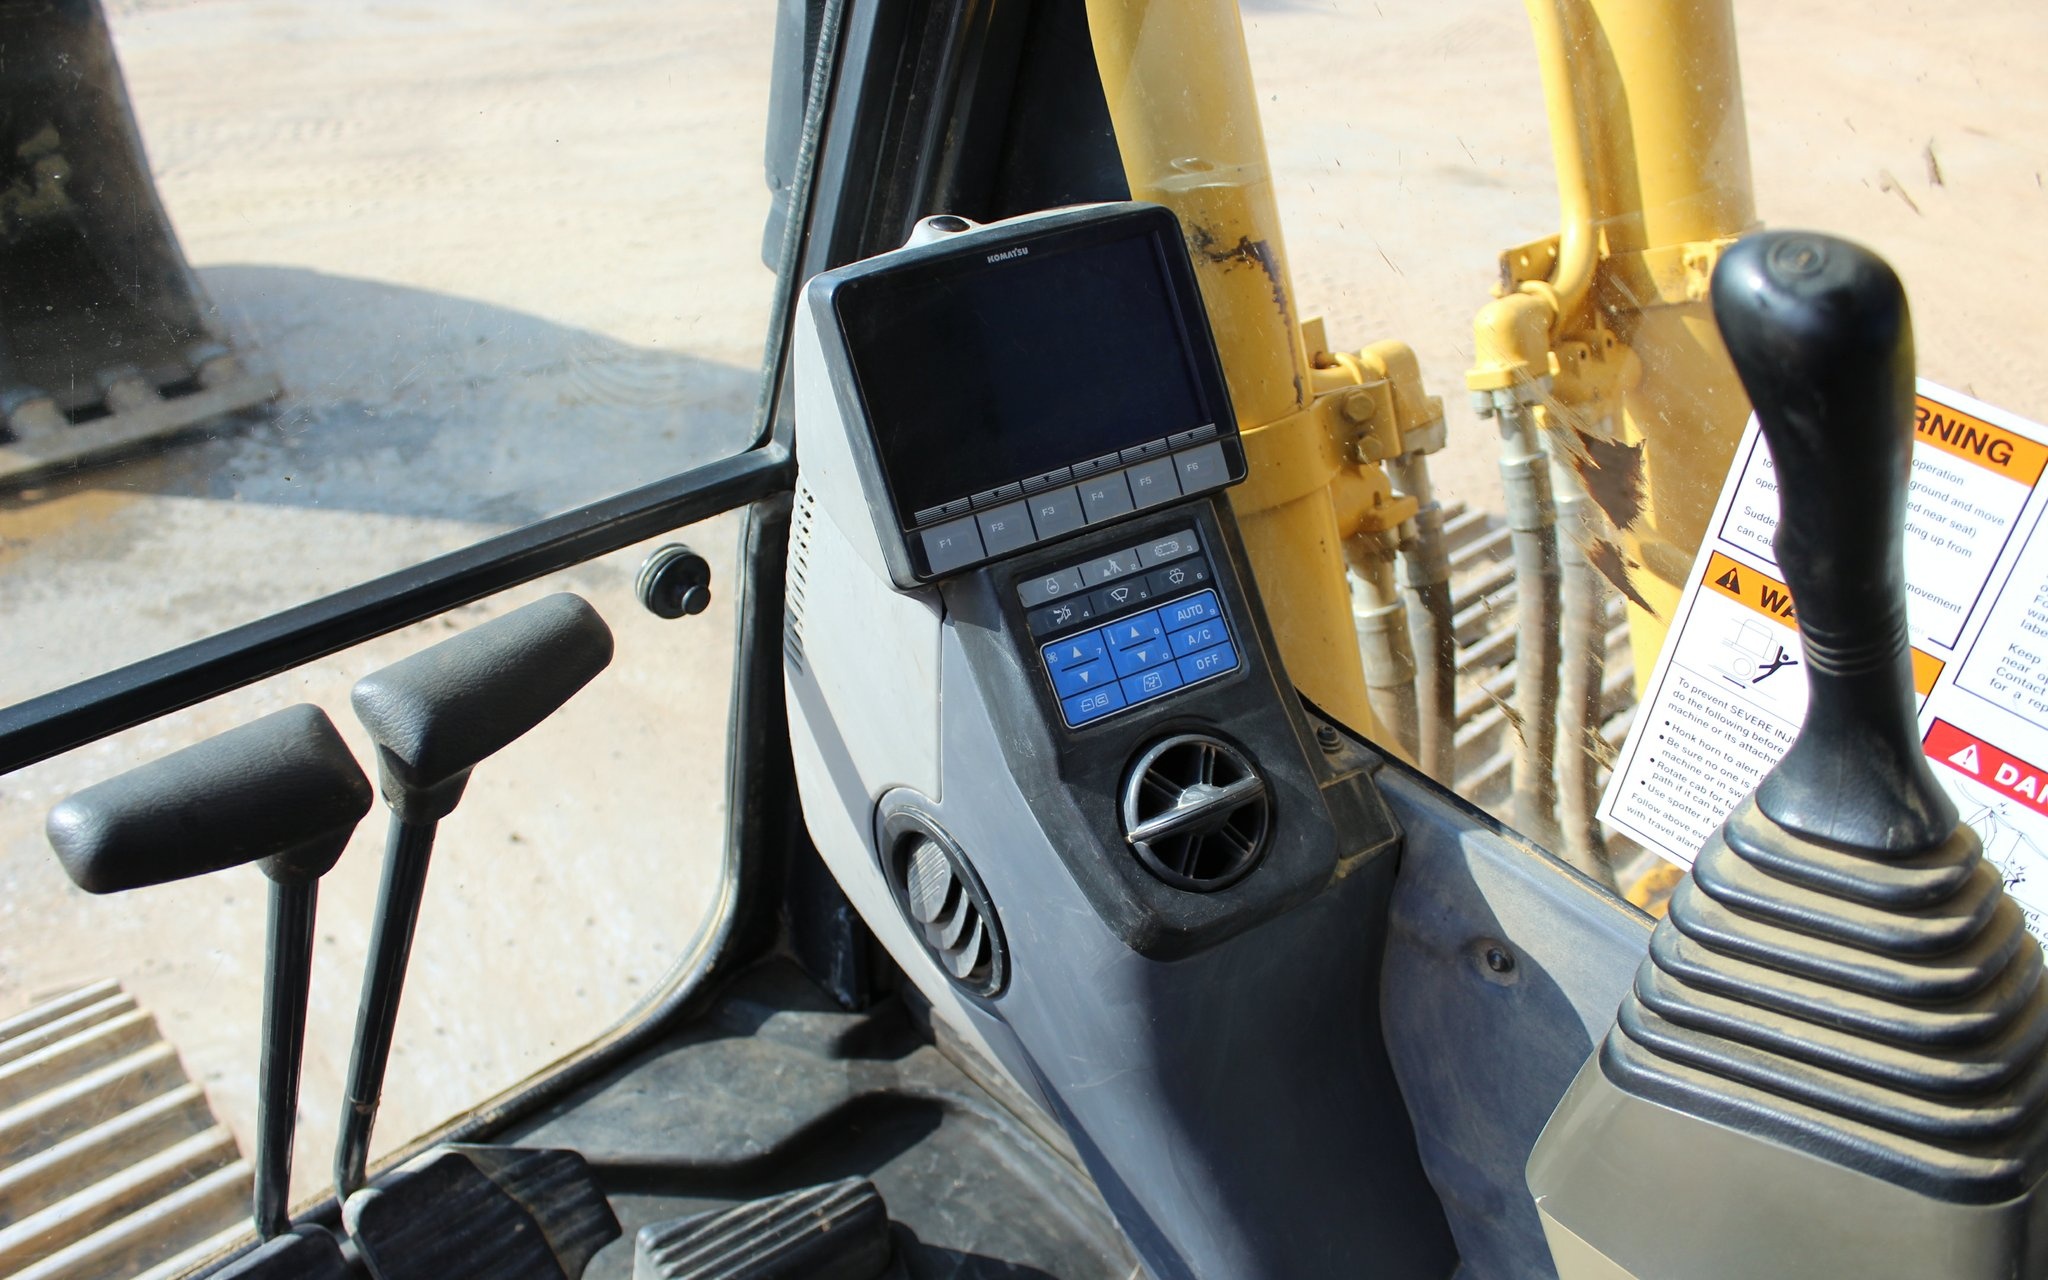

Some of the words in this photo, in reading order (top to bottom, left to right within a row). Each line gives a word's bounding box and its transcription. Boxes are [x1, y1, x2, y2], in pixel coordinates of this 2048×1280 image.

[986, 247, 1029, 263] KOMATSU
[1186, 462, 1200, 472] F6
[1912, 459, 1964, 486] operation
[1139, 476, 1152, 486] F5
[1756, 477, 1778, 492] oper
[1091, 490, 1104, 501] F4
[1908, 480, 1949, 502] ground
[1951, 496, 1973, 512] and
[1974, 510, 2005, 526] move
[1042, 506, 1056, 517] F3
[1923, 509, 1947, 524] near
[1950, 520, 1977, 539] seat)
[990, 522, 1004, 532] F2
[1737, 525, 1755, 537] can
[938, 537, 952, 548] F1
[1930, 534, 1945, 546] up
[1947, 540, 1972, 558] from
[1905, 582, 1962, 613] movement
[1177, 604, 1204, 621] AUTO
[1188, 630, 1211, 645] A/C
[1197, 654, 1219, 670] OFF
[2001, 656, 2031, 673] near
[2008, 643, 2041, 665] Keep
[1989, 678, 2008, 692] for
[2013, 691, 2022, 699] a
[1996, 666, 2046, 696] Contact
[1679, 677, 1690, 689] To
[1691, 686, 1729, 709] prevent
[1730, 705, 1773, 733] SEVERE
[1668, 702, 1709, 729] machine
[1711, 725, 1722, 735] or
[1724, 733, 1737, 744] its
[1673, 690, 1685, 701] do
[1688, 698, 1703, 711] the
[1705, 707, 1750, 738] following
[1752, 732, 1784, 755] before
[1666, 736, 1680, 749] Be
[1682, 746, 1703, 761] sure
[1705, 759, 1718, 770] no
[1720, 768, 1739, 782] one
[1741, 777, 1750, 788] is
[1672, 724, 1697, 742] Honk
[1699, 739, 1722, 757] horn
[1724, 753, 1734, 763] to
[1735, 760, 1759, 777] alert
[1656, 760, 1687, 783] Rotate
[1689, 780, 1707, 795] cab
[1709, 790, 1723, 803] for
[1662, 749, 1702, 776] machine
[1704, 773, 1715, 783] or
[1716, 780, 1726, 790] in
[1647, 784, 1666, 799] Use
[1668, 796, 1701, 819] spotter
[1703, 815, 1711, 825] if
[1651, 772, 1674, 788] path
[1675, 783, 1683, 793] if
[1684, 788, 1691, 798] it
[1692, 795, 1710, 809] can
[1712, 804, 1725, 817] be
[1626, 805, 1646, 821] with
[1648, 817, 1675, 837] travel
[1631, 792, 1661, 814] Follow
[1662, 811, 1690, 832] above
